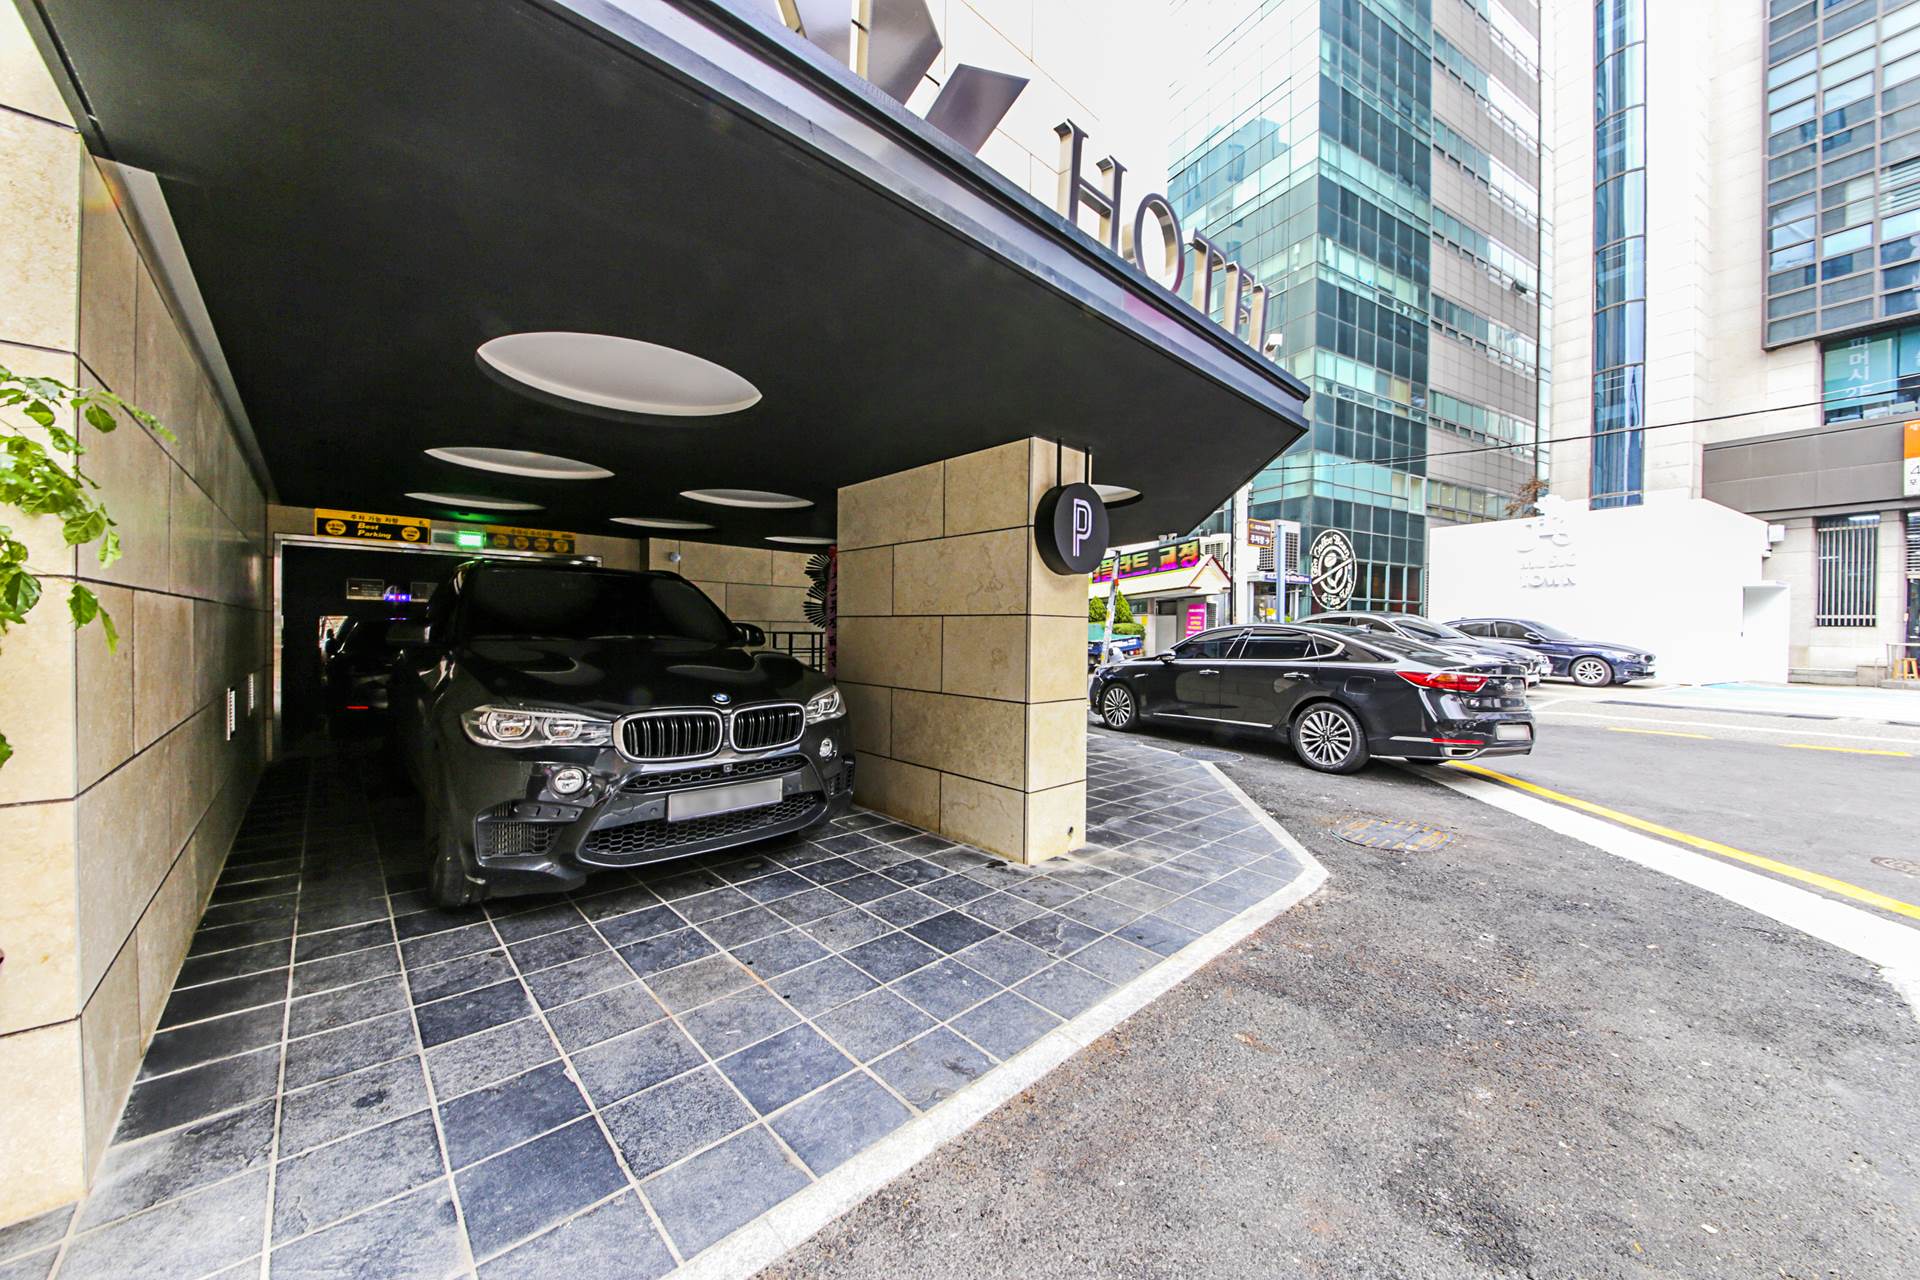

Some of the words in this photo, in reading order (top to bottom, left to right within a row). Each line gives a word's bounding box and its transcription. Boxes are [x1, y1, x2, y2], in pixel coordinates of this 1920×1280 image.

[357, 522, 379, 531] Best
[357, 529, 392, 540] Parking
[1072, 498, 1093, 557] P
[1158, 540, 1199, 571] 교정
[1314, 536, 1334, 557] Coffee
[1332, 534, 1350, 560] Bean
